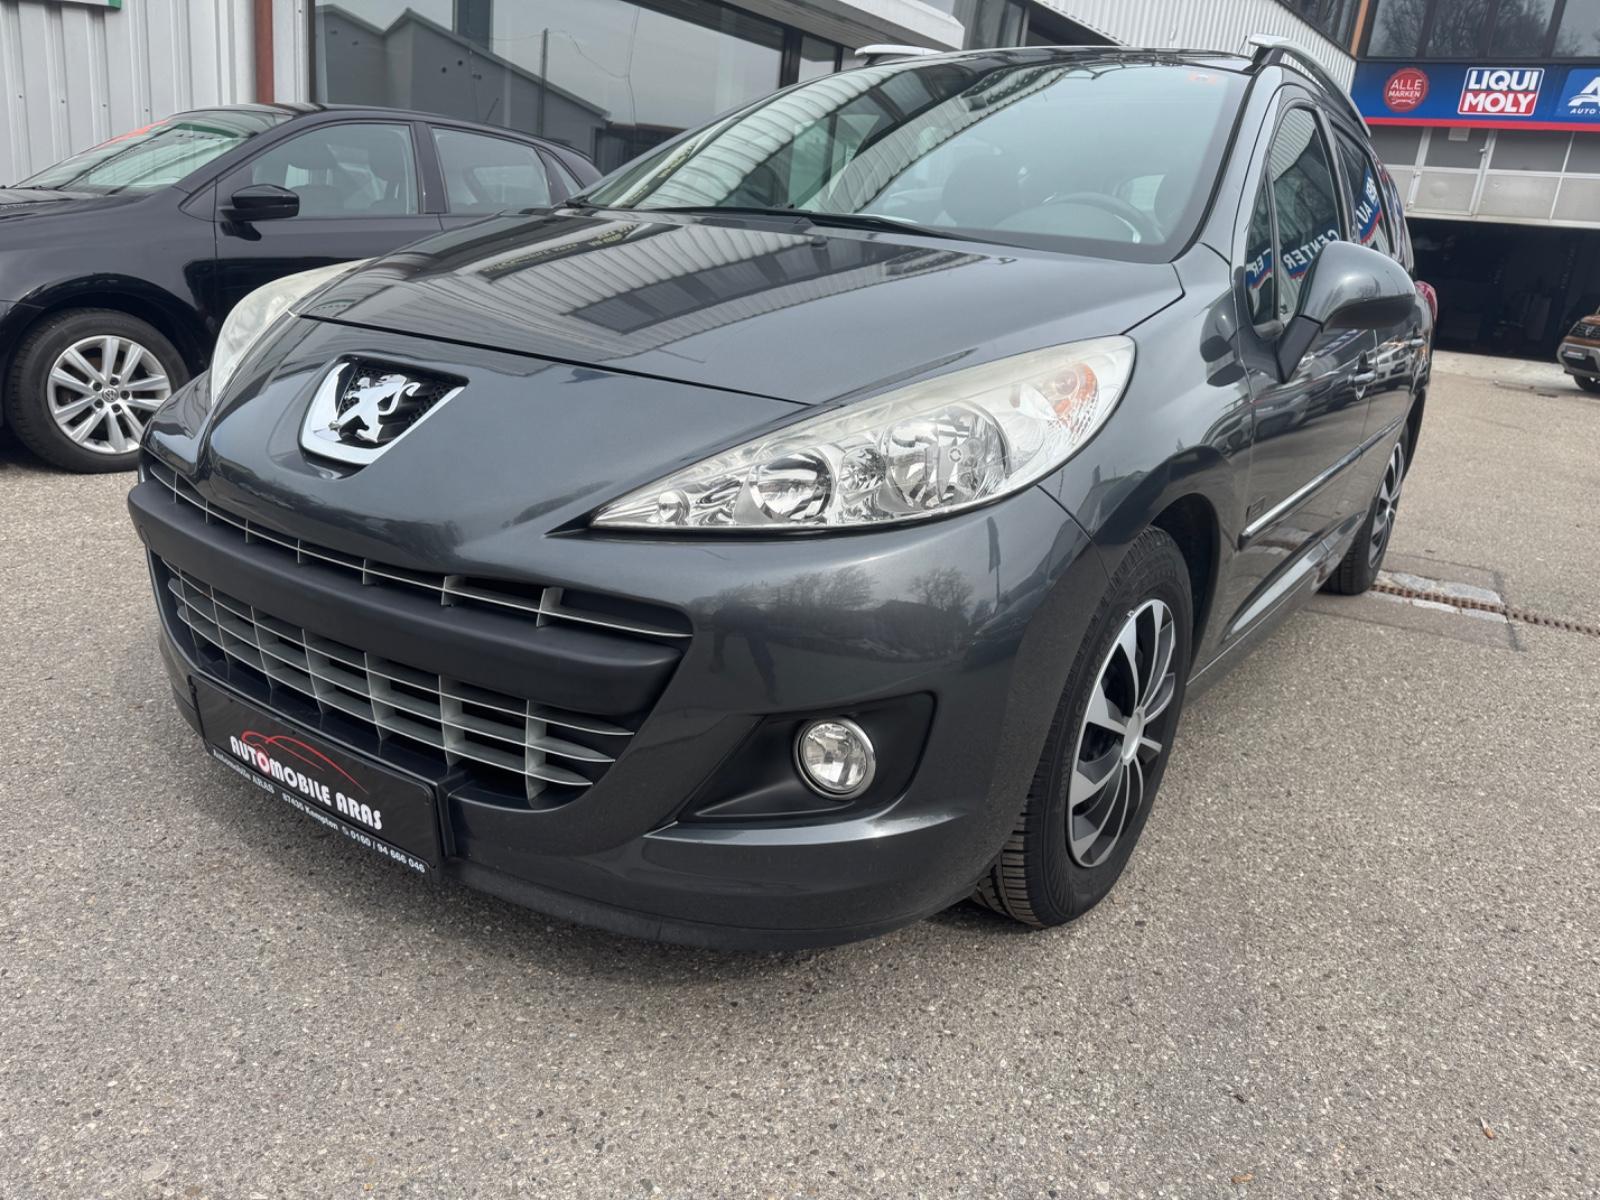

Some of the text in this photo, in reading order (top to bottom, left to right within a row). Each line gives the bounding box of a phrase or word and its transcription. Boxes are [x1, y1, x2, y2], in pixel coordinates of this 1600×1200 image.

[1390, 79, 1423, 91] ALLE
[1468, 70, 1540, 91] LIQUI
[1388, 89, 1421, 98] MARKEN
[1462, 93, 1536, 113] MOLY
[230, 735, 383, 830] AUTOMOBILE ARAS
